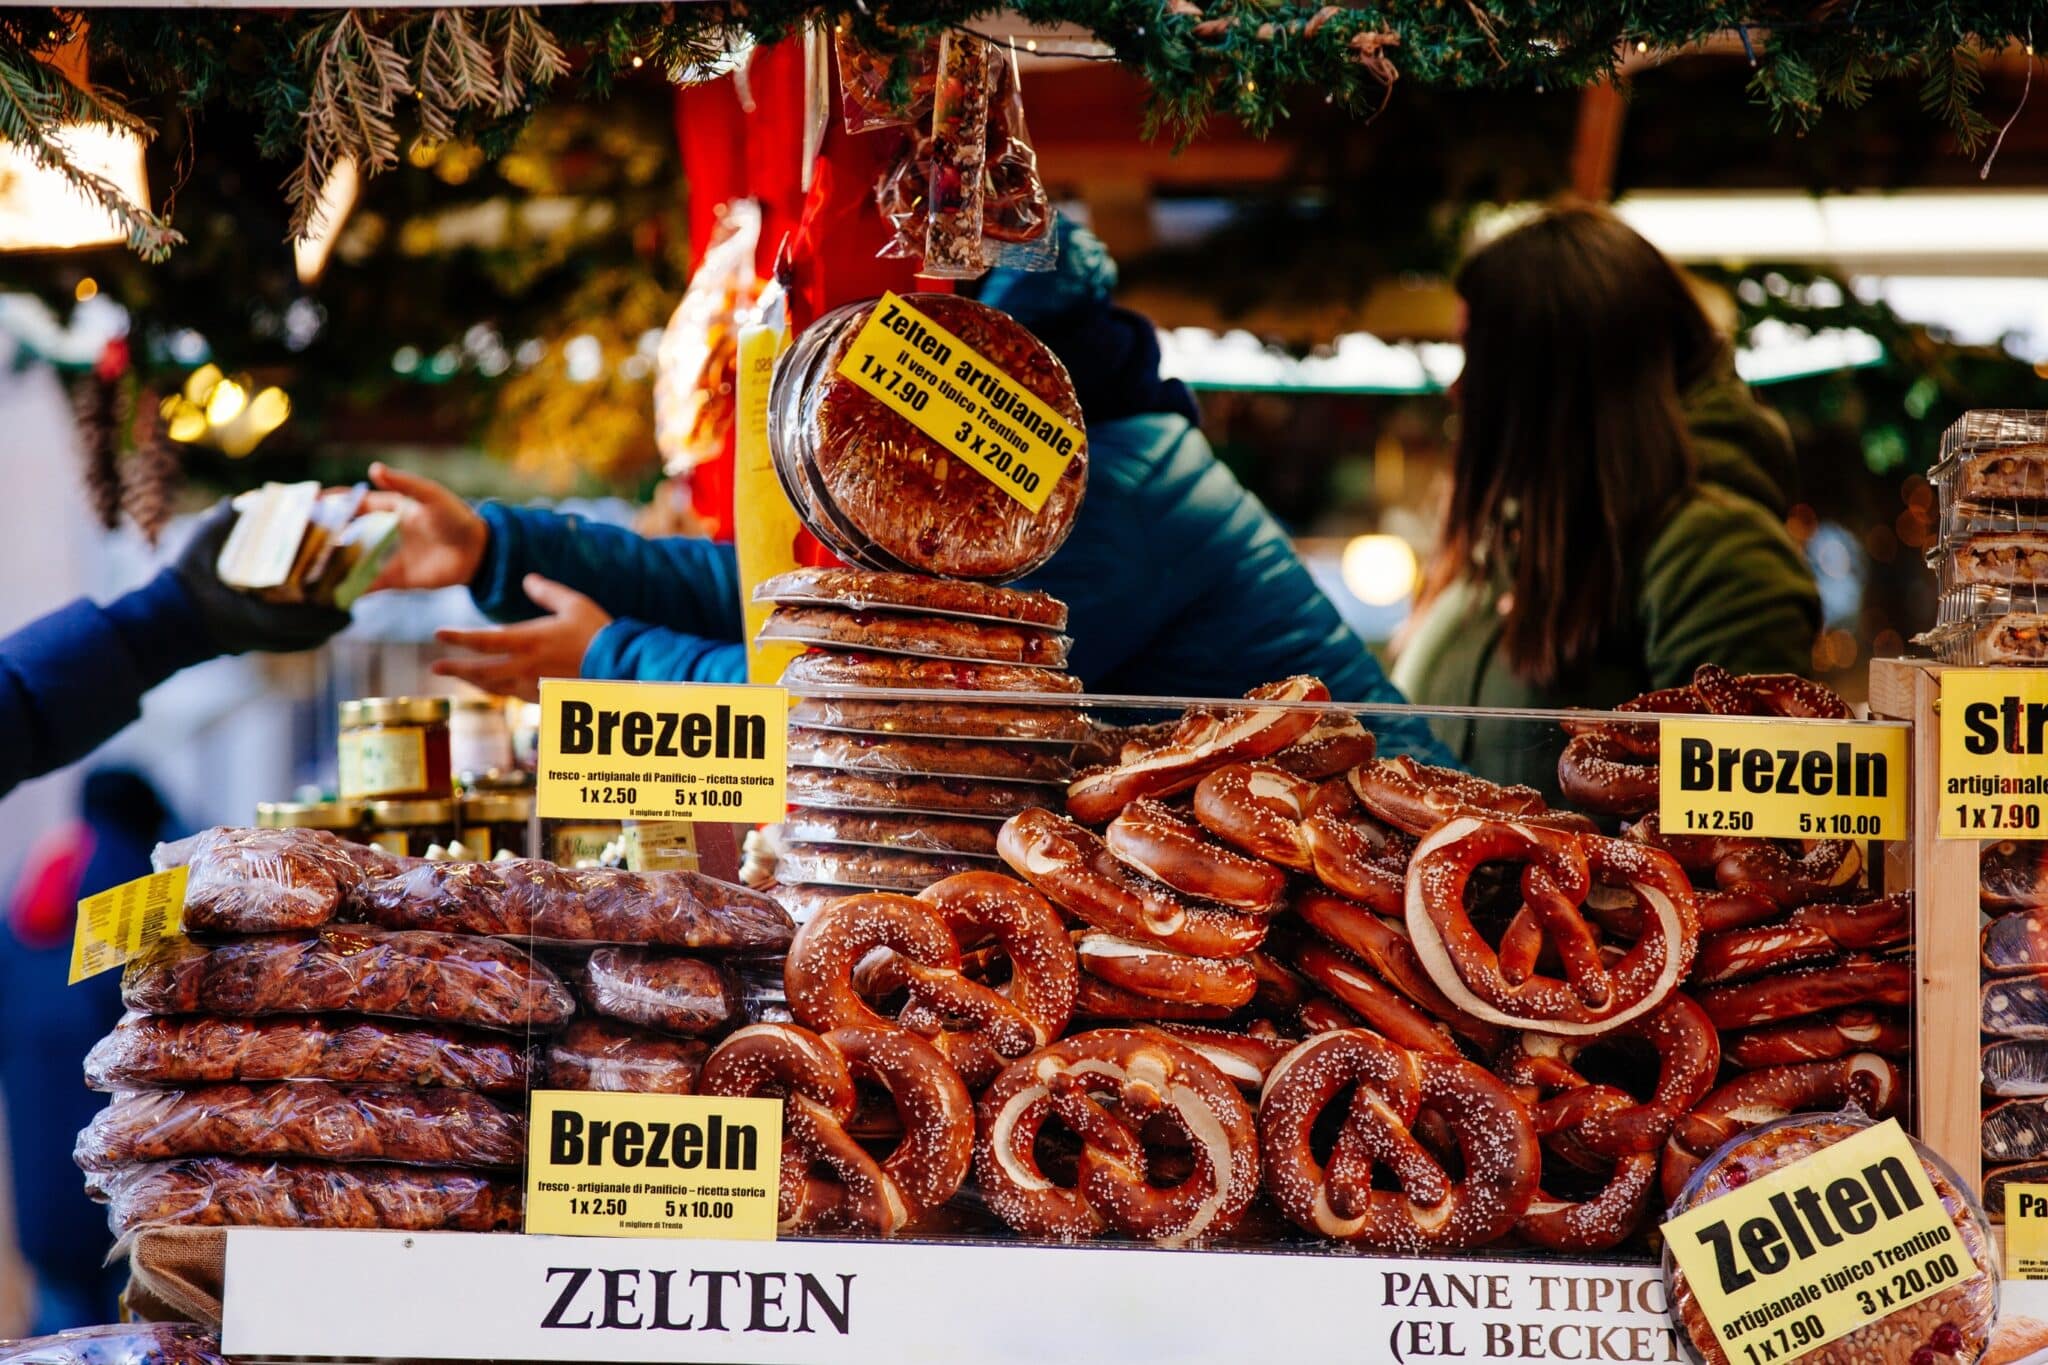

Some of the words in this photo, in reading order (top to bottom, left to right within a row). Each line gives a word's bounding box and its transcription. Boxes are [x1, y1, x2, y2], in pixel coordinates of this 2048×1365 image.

[879, 304, 952, 366] Zelten
[954, 360, 1073, 457] artigianale
[896, 350, 910, 366] il
[908, 359, 939, 386] vero
[937, 379, 977, 414] tipico
[976, 406, 1030, 454] Trentino
[860, 354, 875, 374] 1
[870, 364, 888, 384] x
[885, 370, 930, 412] 7.90
[954, 421, 973, 443] 3
[969, 434, 987, 454] x
[983, 443, 1040, 493] 20.00
[560, 700, 766, 760] Brezeln
[548, 770, 580, 781] fresco
[587, 771, 641, 783] artigianale
[642, 772, 653, 783] di
[654, 772, 697, 784] Panificio
[706, 774, 739, 785] ricetta
[740, 775, 775, 786] storica
[1680, 737, 1888, 798] Brezeln
[580, 787, 587, 803] 1
[591, 789, 600, 803] x
[603, 786, 637, 804] 2.50
[675, 789, 685, 806] 5
[688, 792, 697, 806] x
[701, 790, 743, 807] 10.00
[663, 809, 671, 817] di
[671, 809, 693, 818] Trento
[1956, 804, 1967, 829] 1
[1973, 808, 1986, 829] x
[1991, 804, 2040, 830] 7.90
[1685, 810, 1694, 829] 1
[1698, 813, 1709, 829] x
[1712, 810, 1754, 831] 2.50
[1799, 813, 1812, 833] 5
[1815, 817, 1827, 833] x
[1830, 814, 1881, 835] 10.00
[549, 1110, 758, 1171] Brezeln
[538, 1181, 570, 1192] fresco
[577, 1182, 631, 1194] artigianale
[632, 1183, 643, 1194] di
[644, 1183, 688, 1196] Panificio
[697, 1185, 730, 1197] ricetta
[731, 1187, 766, 1198] storica
[570, 1197, 577, 1214] 1
[580, 1200, 589, 1215] x
[592, 1198, 627, 1216] 2.50
[665, 1200, 676, 1217] 5
[679, 1203, 688, 1218] x
[691, 1201, 734, 1219] 10.00
[2019, 1193, 2048, 1218] Pa
[653, 1221, 661, 1229] di
[661, 1221, 683, 1230] Trento
[1695, 1156, 1924, 1296] Zelten
[541, 1267, 857, 1334] ZELTEN
[1380, 1272, 1513, 1310] PANE
[1722, 1284, 1822, 1341] artigianale
[1820, 1259, 1875, 1294] tipico
[1872, 1225, 1951, 1269] Trentino
[1743, 1343, 1764, 1365] 1
[1758, 1339, 1779, 1362] x
[1773, 1314, 1825, 1354] 7.90
[1856, 1290, 1877, 1316] 3
[1875, 1285, 1896, 1308] x
[1891, 1253, 1959, 1300] 20.00
[1389, 1320, 1467, 1365] (EL
